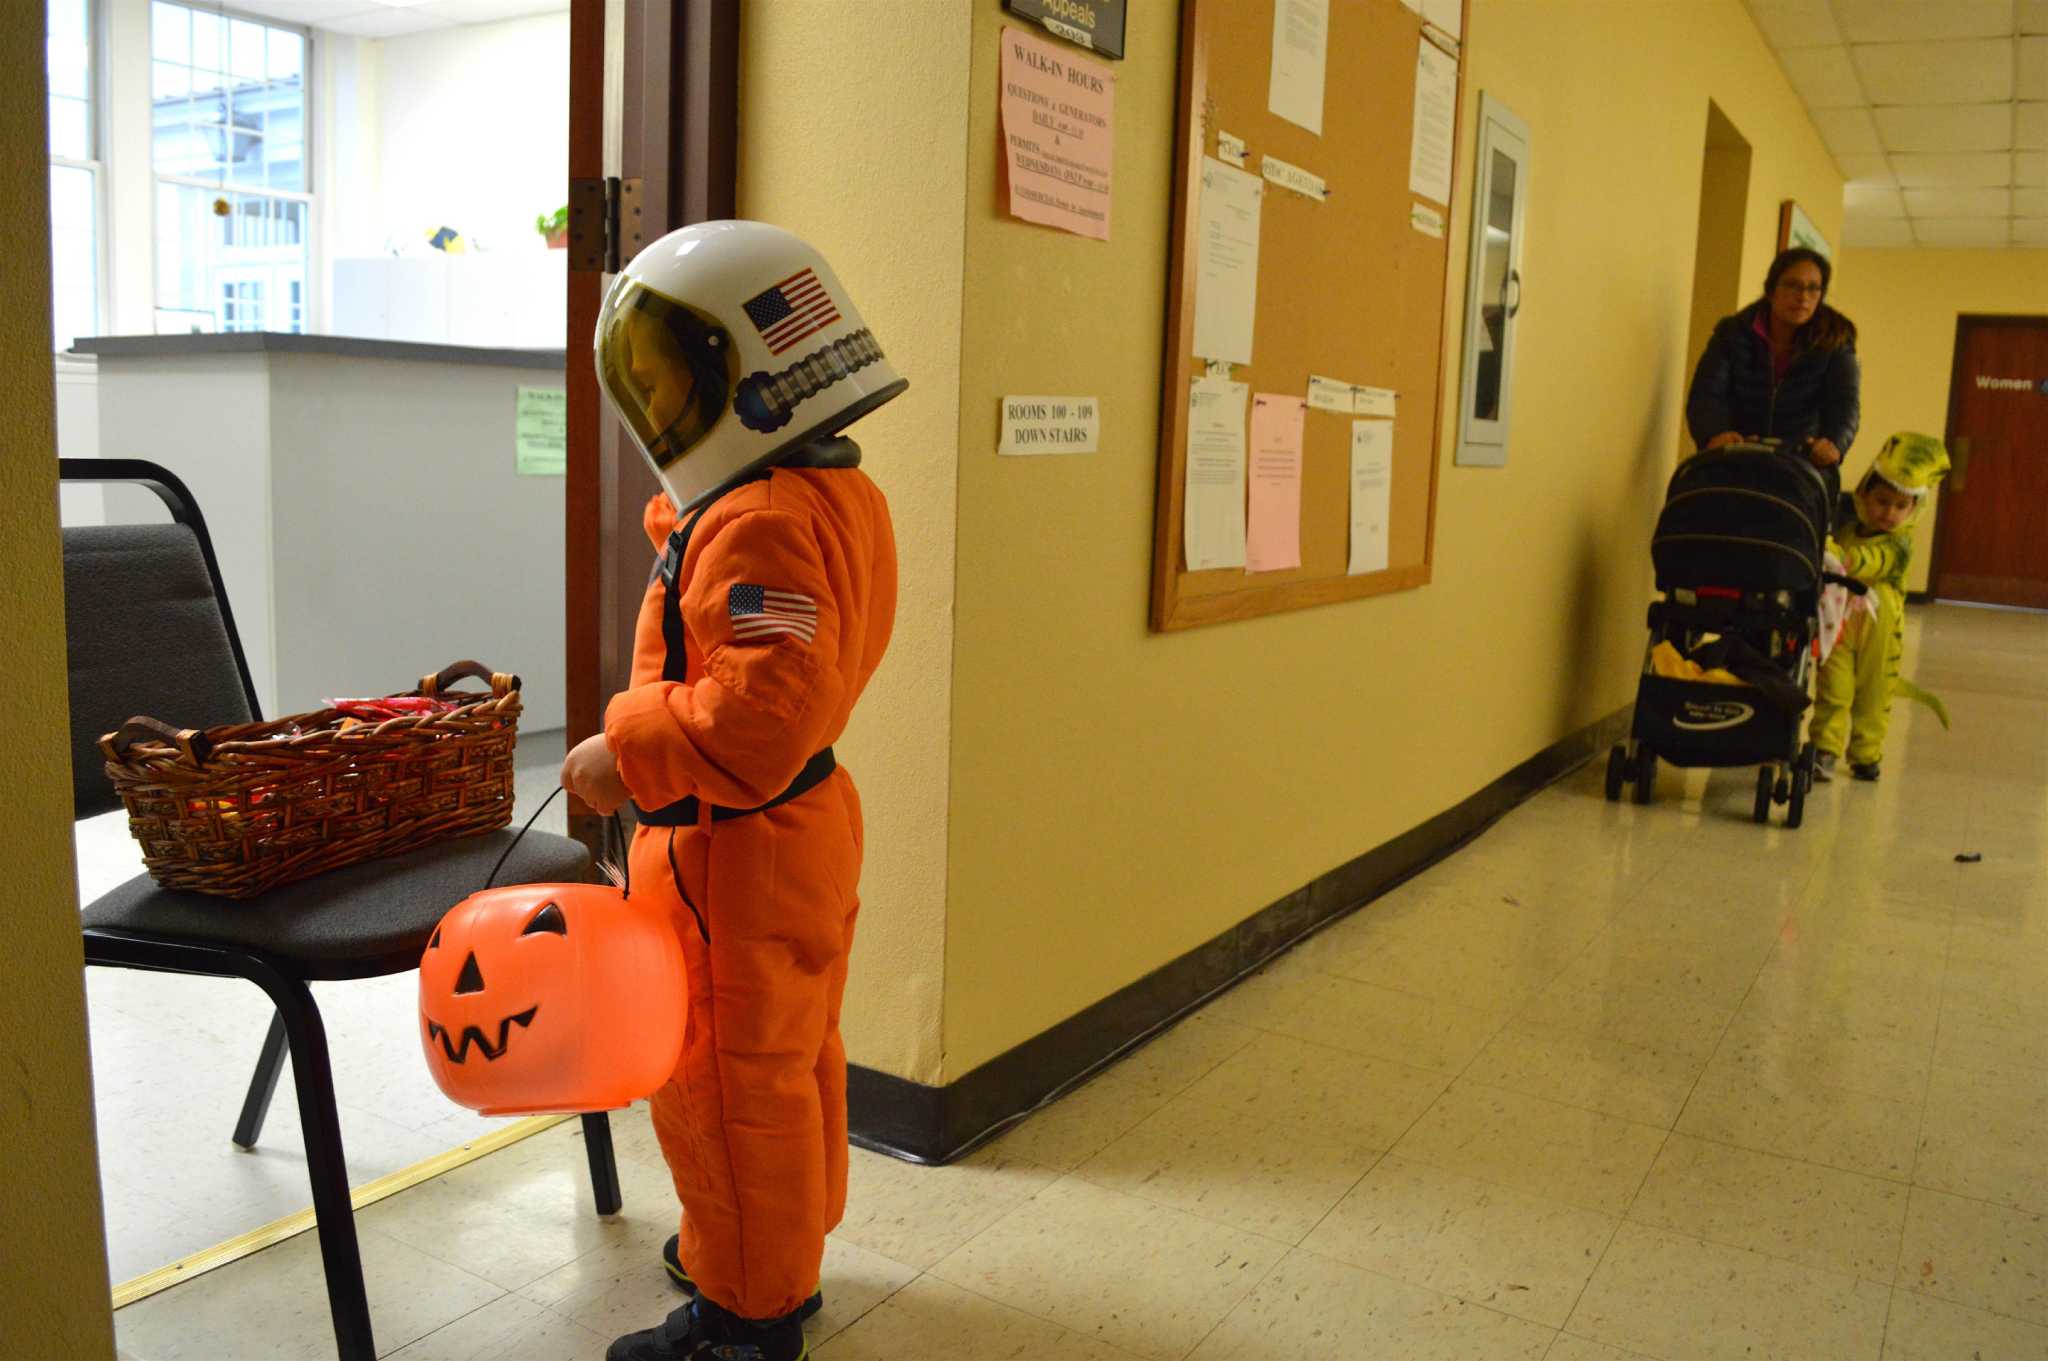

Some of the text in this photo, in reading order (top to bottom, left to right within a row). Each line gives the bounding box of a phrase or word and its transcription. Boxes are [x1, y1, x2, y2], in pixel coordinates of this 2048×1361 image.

[1014, 44, 1104, 94] WALK-IN HOURS
[1007, 82, 1049, 108] QUESTIONS
[1058, 102, 1107, 129] GENERATORS
[1976, 375, 2033, 391] Women
[1008, 404, 1047, 421] ROOMS
[1052, 404, 1066, 420] 100
[1077, 404, 1093, 420] 109
